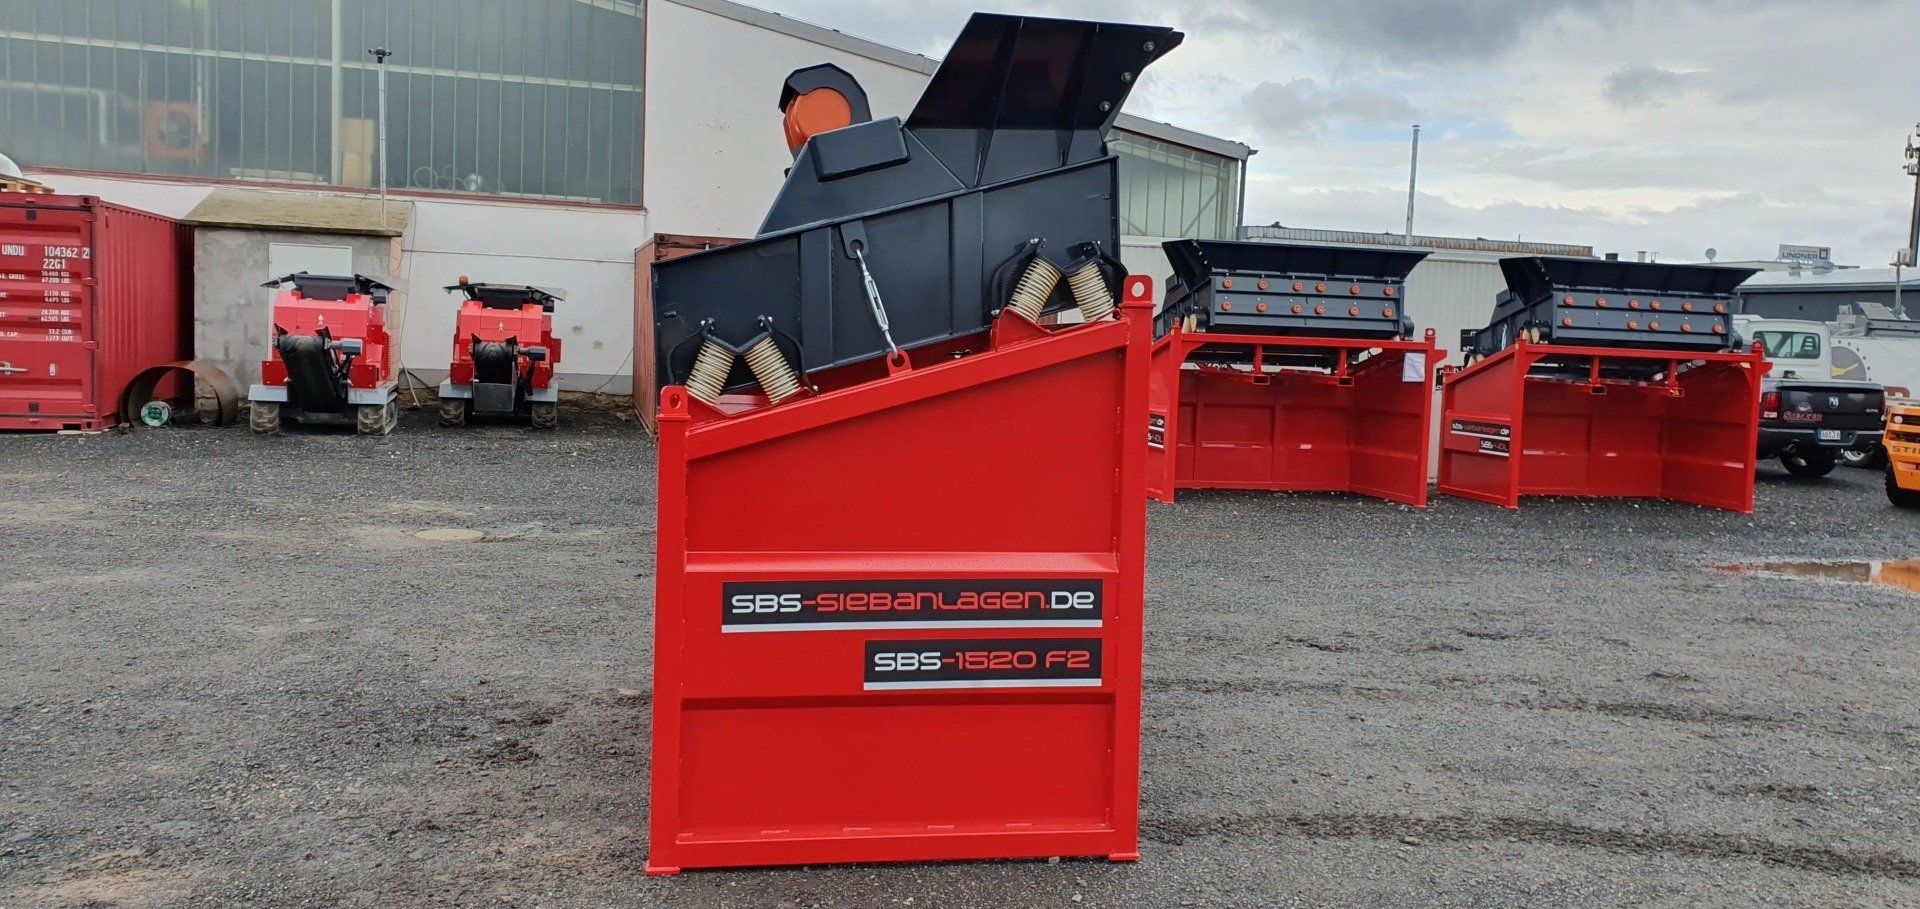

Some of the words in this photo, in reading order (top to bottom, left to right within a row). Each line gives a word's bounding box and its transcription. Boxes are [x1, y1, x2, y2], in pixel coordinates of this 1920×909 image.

[1, 244, 24, 256] UNDU
[44, 246, 78, 258] 104362
[82, 247, 90, 259] 2
[1782, 252, 1818, 260] LINDNER
[42, 259, 66, 269] 22G1
[873, 650, 1038, 672] SBS-1520
[1045, 650, 1090, 669] F2
